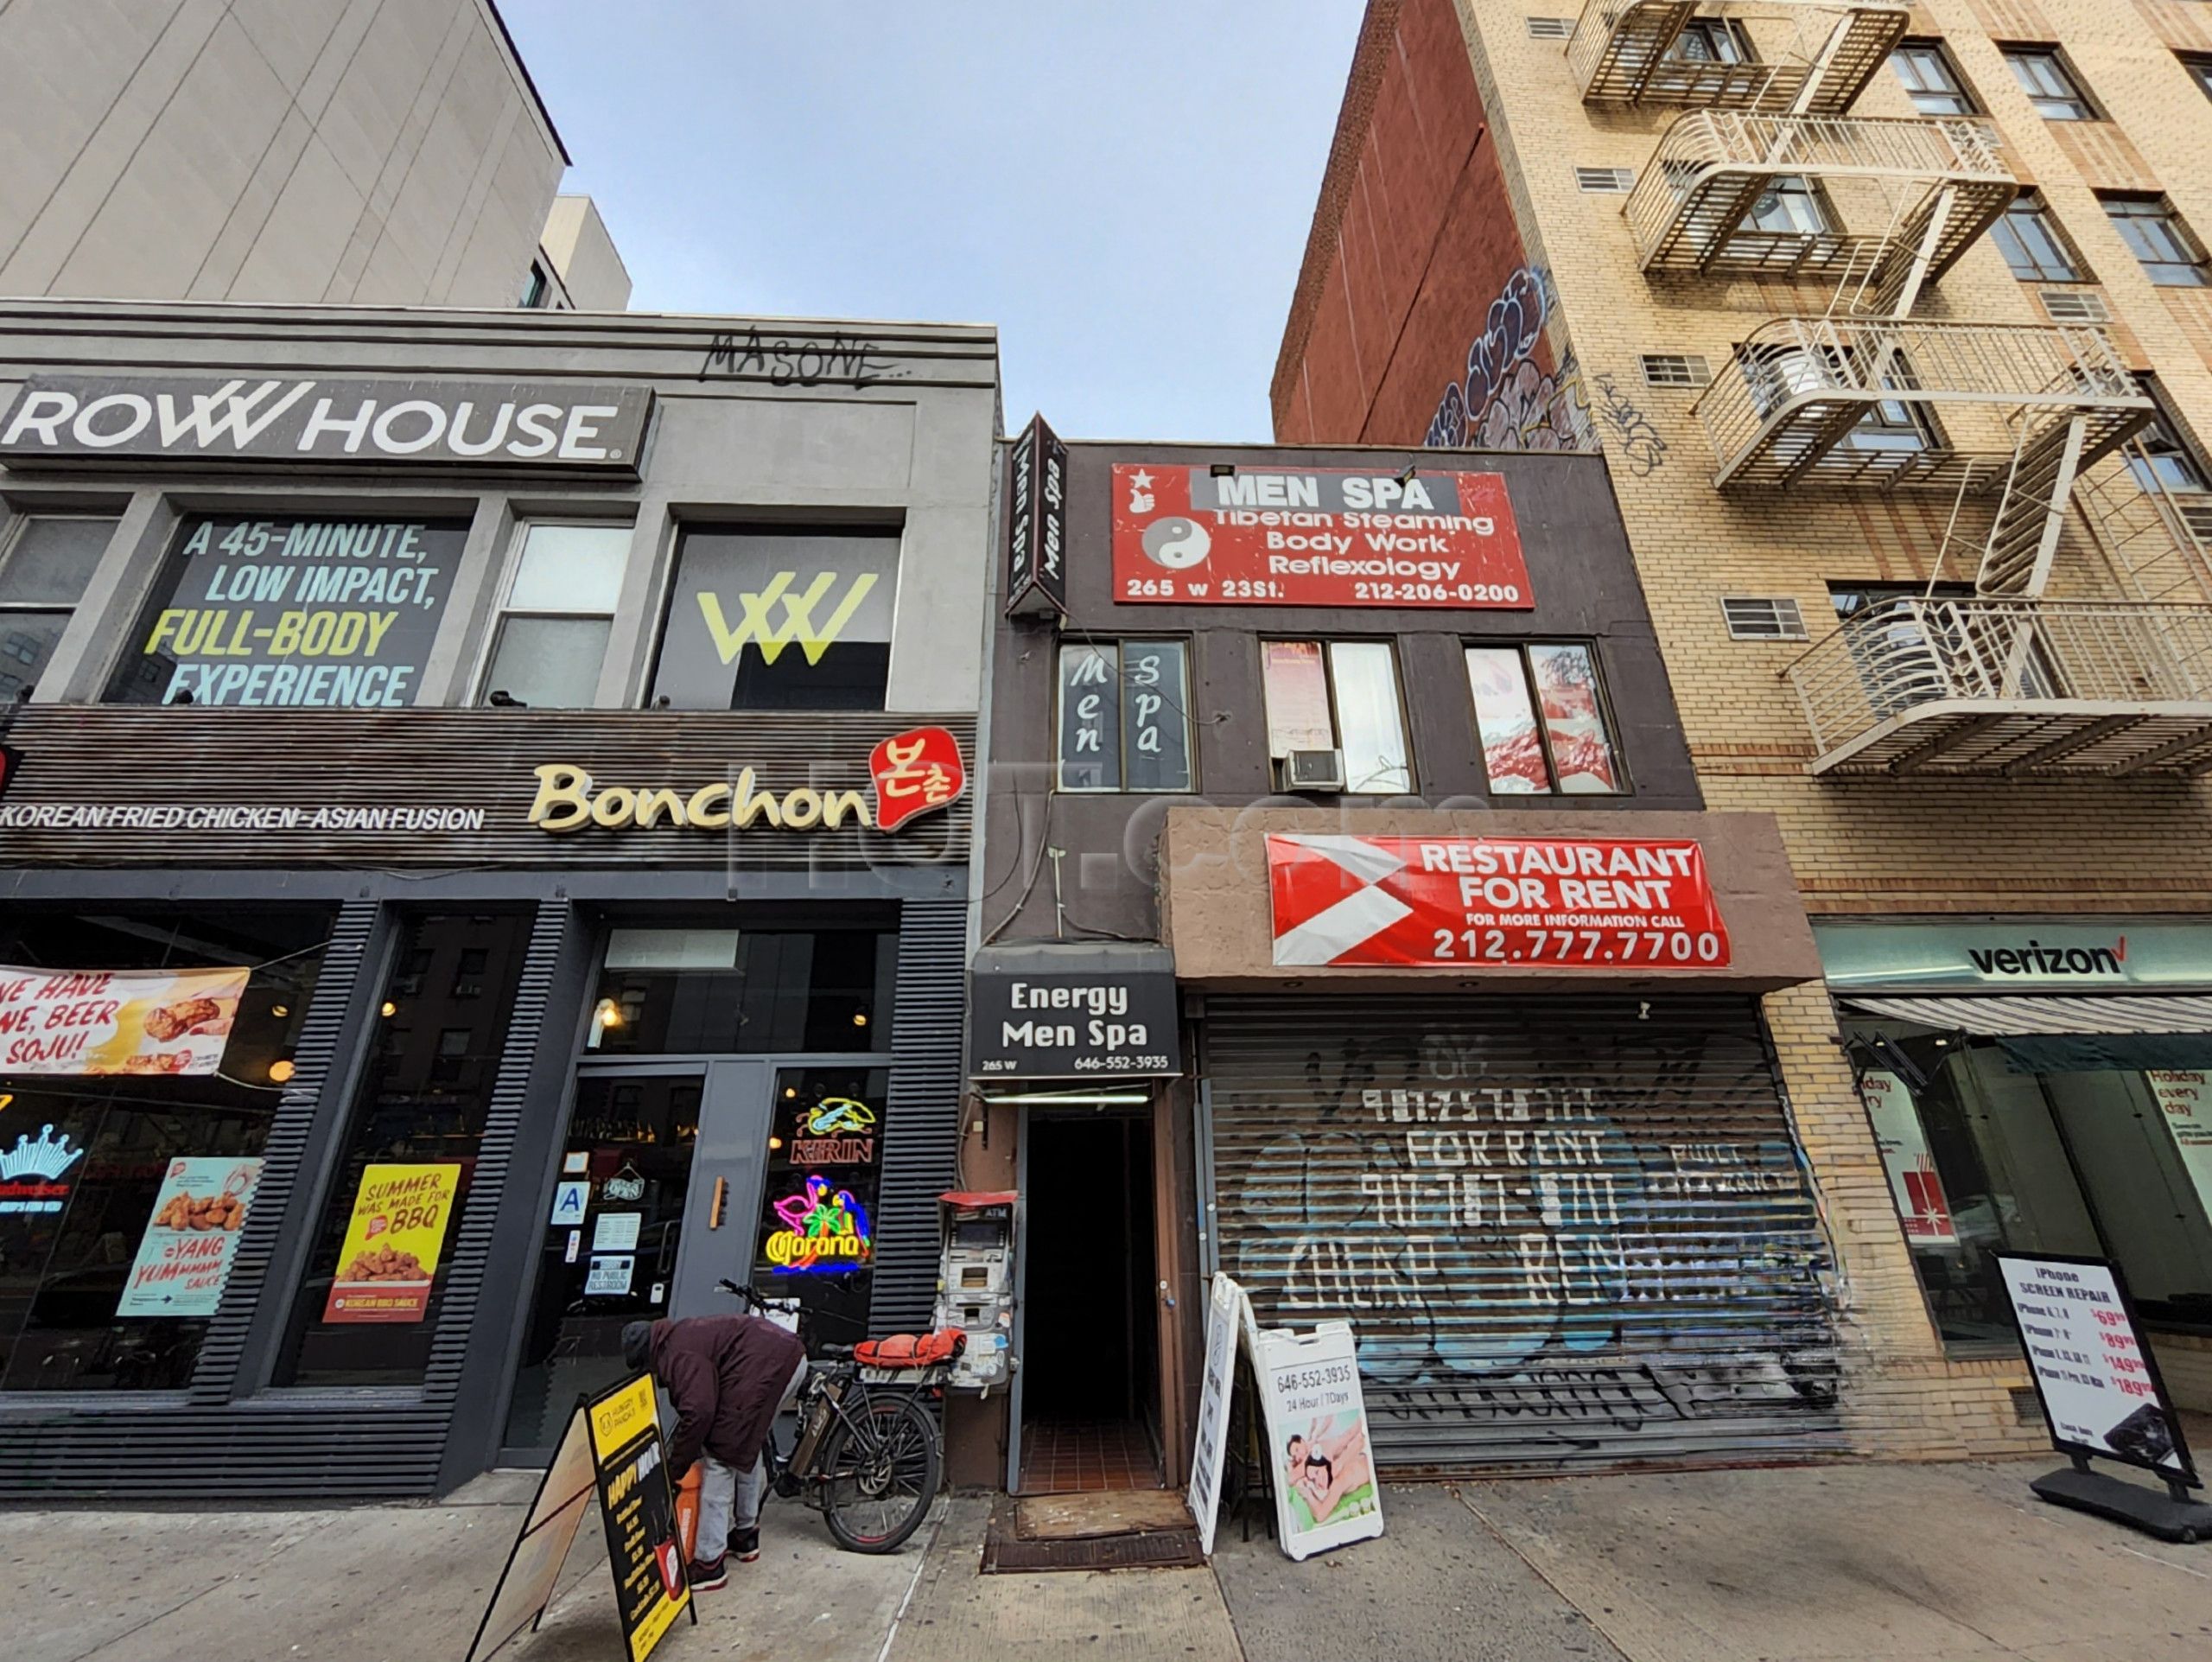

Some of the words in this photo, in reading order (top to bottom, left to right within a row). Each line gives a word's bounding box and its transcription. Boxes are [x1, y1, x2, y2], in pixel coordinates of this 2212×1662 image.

[297, 398, 618, 460] HOUSE
[1045, 457, 1062, 510] Spa
[1217, 474, 1319, 508] MEN
[1342, 476, 1434, 511] SPA
[1212, 509, 1333, 528] Tibetan
[1344, 511, 1494, 536] Steaming
[183, 522, 208, 556] A
[218, 523, 428, 563] 45-MINUTE,
[1044, 513, 1059, 580] Men
[1267, 532, 1352, 554] Body
[1365, 532, 1447, 554] Work
[1268, 556, 1460, 580] Reflexology
[205, 565, 299, 602] LOW
[303, 567, 439, 608] IMPACT,
[1127, 579, 1175, 597] 265
[1355, 583, 1519, 602] 212-206-0200
[144, 610, 398, 658] FULL-BODY
[162, 664, 415, 707] EXPERIENCE
[1070, 654, 1108, 753] Men
[1135, 655, 1162, 753] Spa
[878, 737, 951, 804] 본촌
[527, 763, 874, 831] Bonchon
[0, 805, 105, 827] KOREAN
[105, 806, 185, 829] FRIED
[388, 809, 484, 830] FUSION
[1420, 844, 1694, 878] RESTAURANT
[1460, 876, 1551, 909] FOR
[1559, 879, 1672, 910] RENT
[1466, 913, 1496, 927] FOR
[1499, 914, 1541, 927] MORE
[1544, 914, 1647, 927] INFORMATION
[1651, 915, 1685, 928] CALL
[1433, 929, 1719, 961] 212.777.7700
[1969, 940, 2121, 975] verizon
[35, 972, 115, 1000] HAVE
[1011, 983, 1128, 1016] Energy
[45, 1000, 120, 1029] BEER
[6, 1031, 90, 1065] SOJU!
[1002, 1021, 1076, 1048] Men
[1088, 1019, 1147, 1051] Spa
[982, 1060, 1002, 1071] 265
[1004, 1060, 1018, 1070] W
[1074, 1056, 1168, 1070] 646-552-3935
[2158, 1088, 2198, 1101] every
[2165, 1101, 2191, 1117] day
[790, 1138, 874, 1164] KIRIN
[1407, 1130, 1492, 1166] FOR
[1504, 1130, 1605, 1166] RENT
[358, 1201, 385, 1217] WAS
[389, 1194, 422, 1211] MADE
[427, 1189, 451, 1204] FOR
[365, 1173, 442, 1202] SUMMER
[560, 1188, 579, 1211] A
[390, 1204, 439, 1234] BBQ
[985, 1209, 1007, 1218] ATM
[766, 1231, 859, 1265] Corona
[2036, 1267, 2080, 1283] iPhone
[2019, 1283, 2065, 1299] SCREEN
[2066, 1288, 2111, 1303] REPAIR
[1278, 1366, 1351, 1393] 646-552-3935
[1287, 1400, 1297, 1412] 24
[1299, 1395, 1319, 1410] Hour
